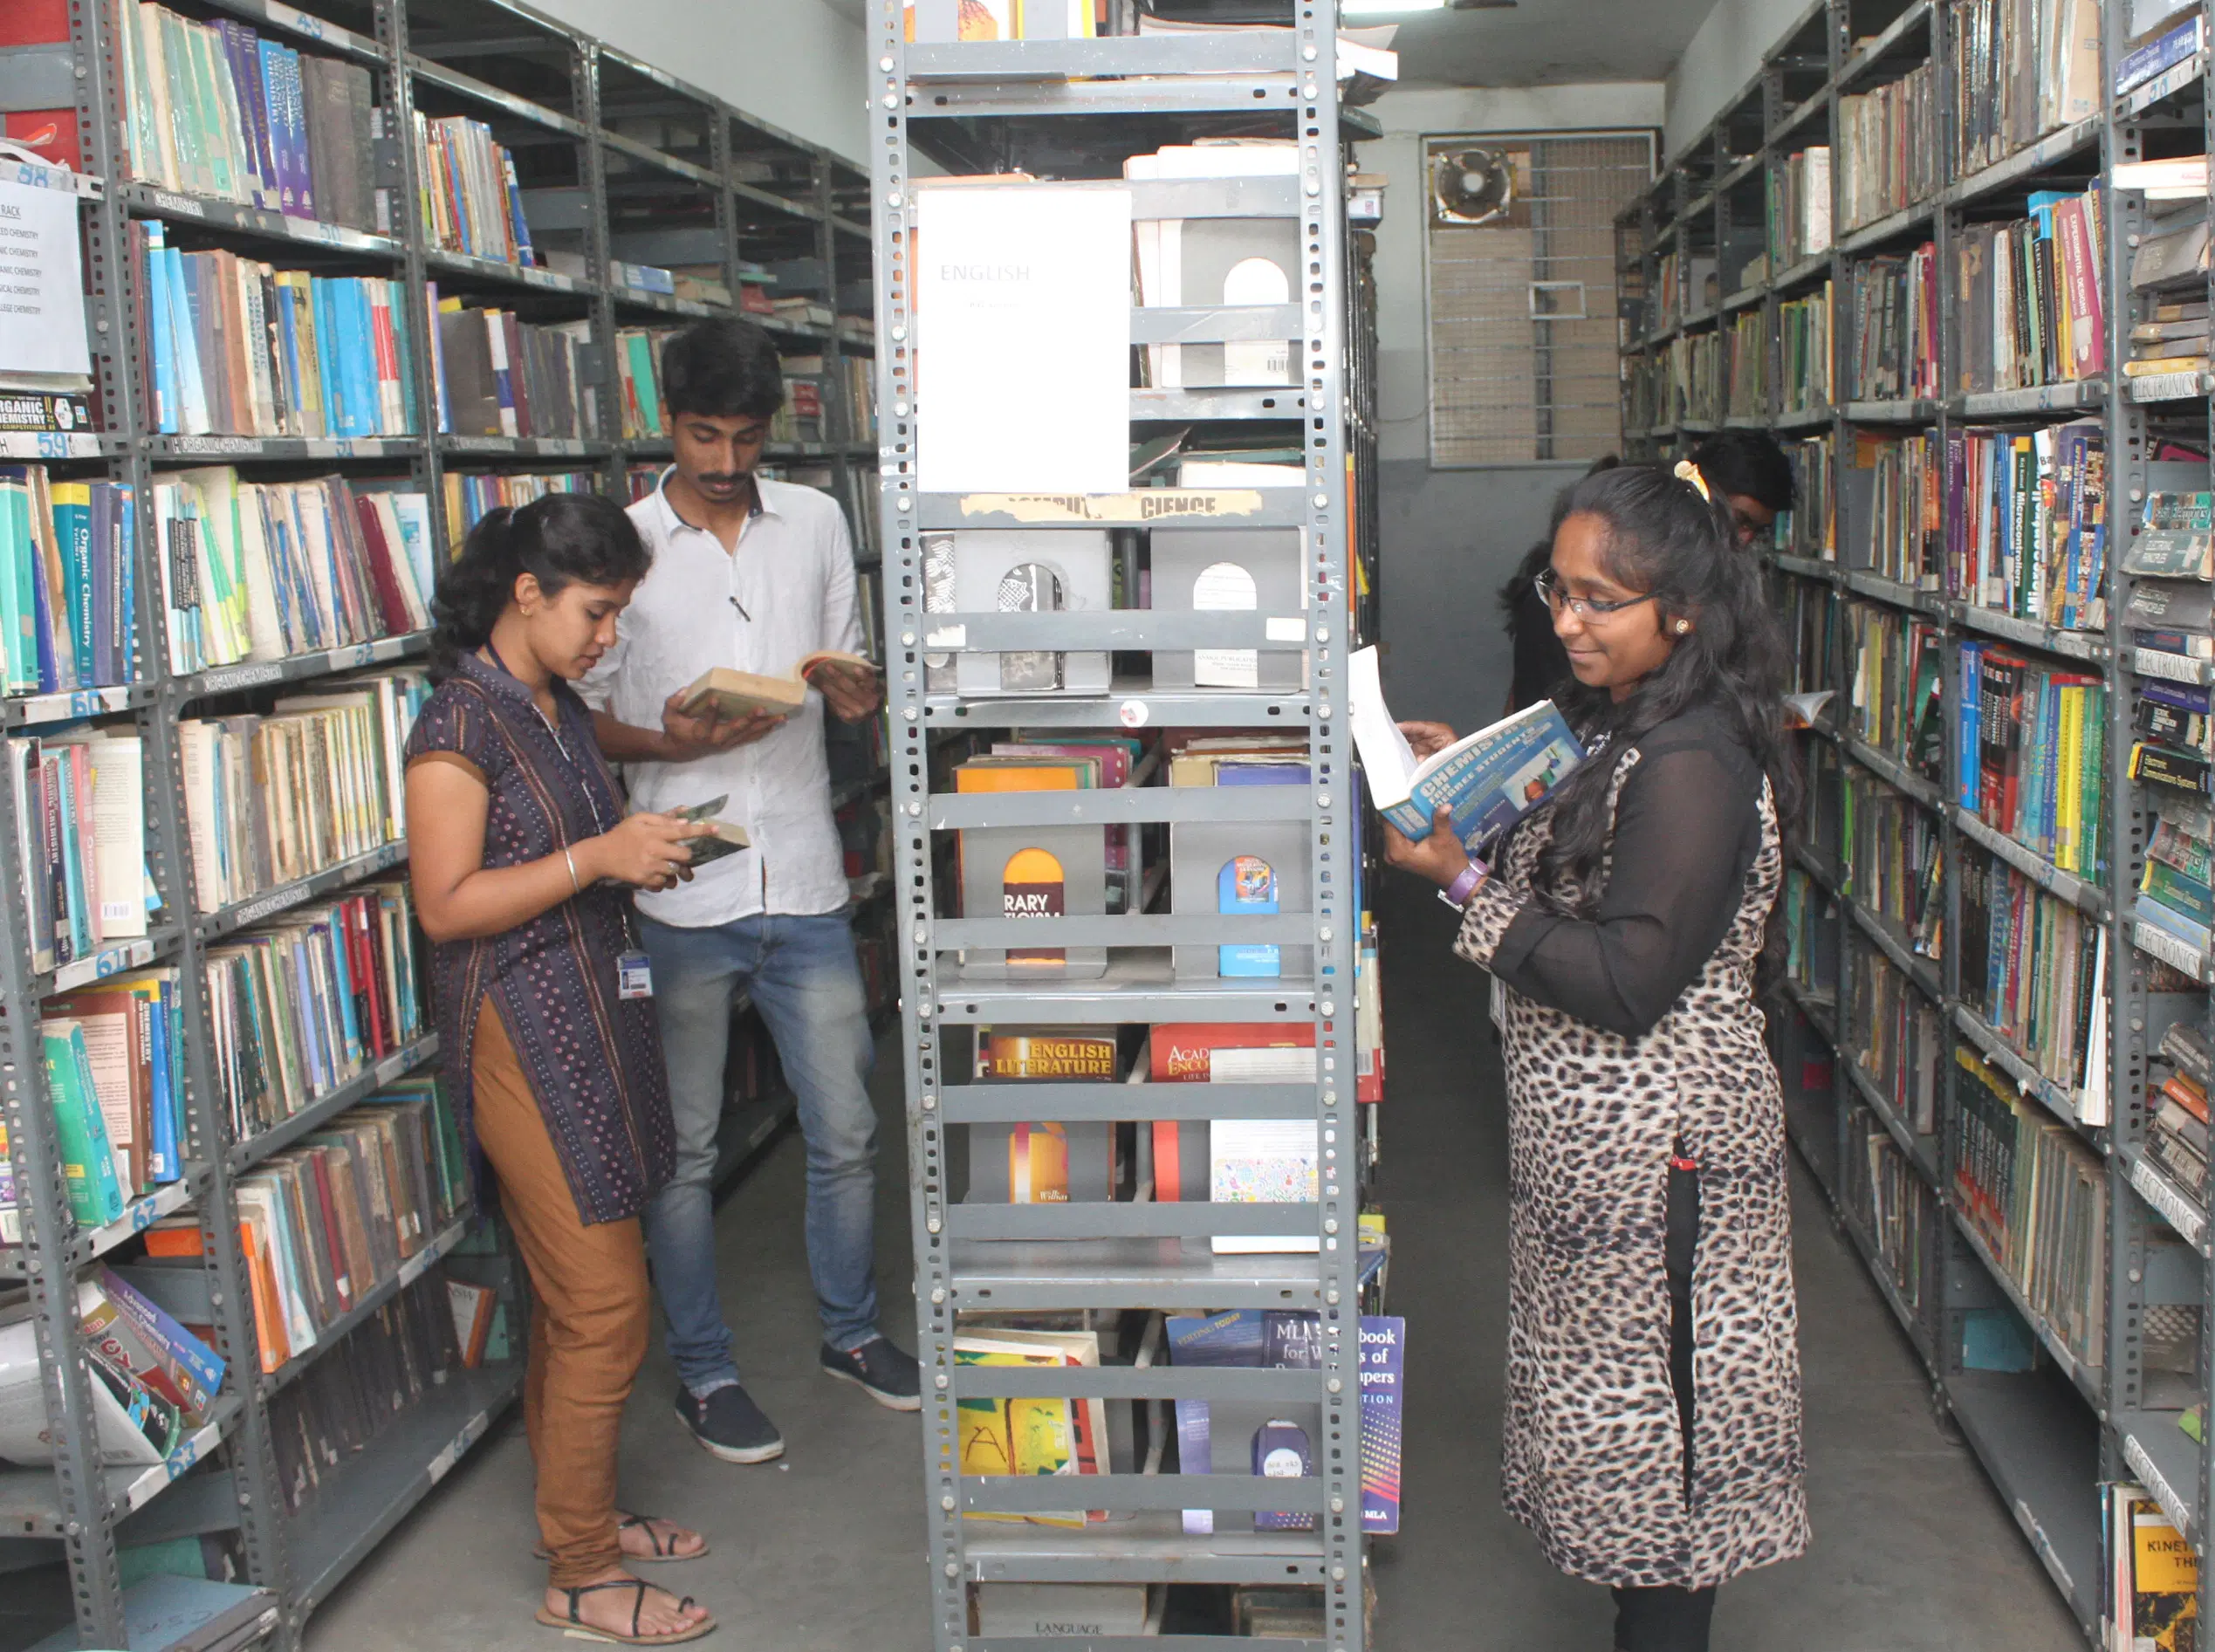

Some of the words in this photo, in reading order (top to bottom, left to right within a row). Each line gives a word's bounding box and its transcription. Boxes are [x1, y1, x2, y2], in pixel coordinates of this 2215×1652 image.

[266, 51, 279, 125] CHEMISTRY
[1, 203, 21, 217] RACK
[154, 193, 204, 217] CHEMISTRY
[9, 227, 38, 240] CHEMISTRY
[2070, 212, 2083, 276] EXPERIMENTAL
[9, 247, 38, 259] CHEMISTRY
[14, 266, 42, 278] CHEMISTRY
[941, 264, 1031, 282] ENGLISH
[2034, 243, 2043, 296] ELECTRONIC
[14, 285, 40, 297] CHEMISTRY
[2076, 277, 2087, 316] DESIGNS
[14, 305, 42, 315] CHEMISTRY
[2133, 372, 2196, 401] ELECTRONICS
[37, 432, 68, 458] 59
[2014, 490, 2026, 587] Microcontrollers
[80, 527, 90, 580] Organic
[82, 583, 91, 648] Chemistry
[1419, 717, 1529, 798] CHEMISTRY
[1475, 725, 1536, 773] STUDENTS
[2037, 743, 2047, 776] VLSI
[1429, 781, 1451, 804] FOR
[1004, 894, 1048, 911] RARY
[2136, 922, 2200, 978] ELECTRONICS
[95, 948, 127, 978] 61
[1030, 1043, 1111, 1059] ENGLISH
[995, 1059, 1111, 1074] LITERATURE
[2133, 1162, 2198, 1241] ELECTRONICS
[132, 1196, 163, 1232] 62
[137, 1313, 171, 1351] Chemistry
[1276, 1321, 1313, 1341] MLA
[1359, 1329, 1396, 1345] book
[1283, 1344, 1304, 1361] for
[1372, 1348, 1389, 1364] of
[1365, 1509, 1388, 1520] MLA
[1035, 1621, 1103, 1635] LANGUAGE
